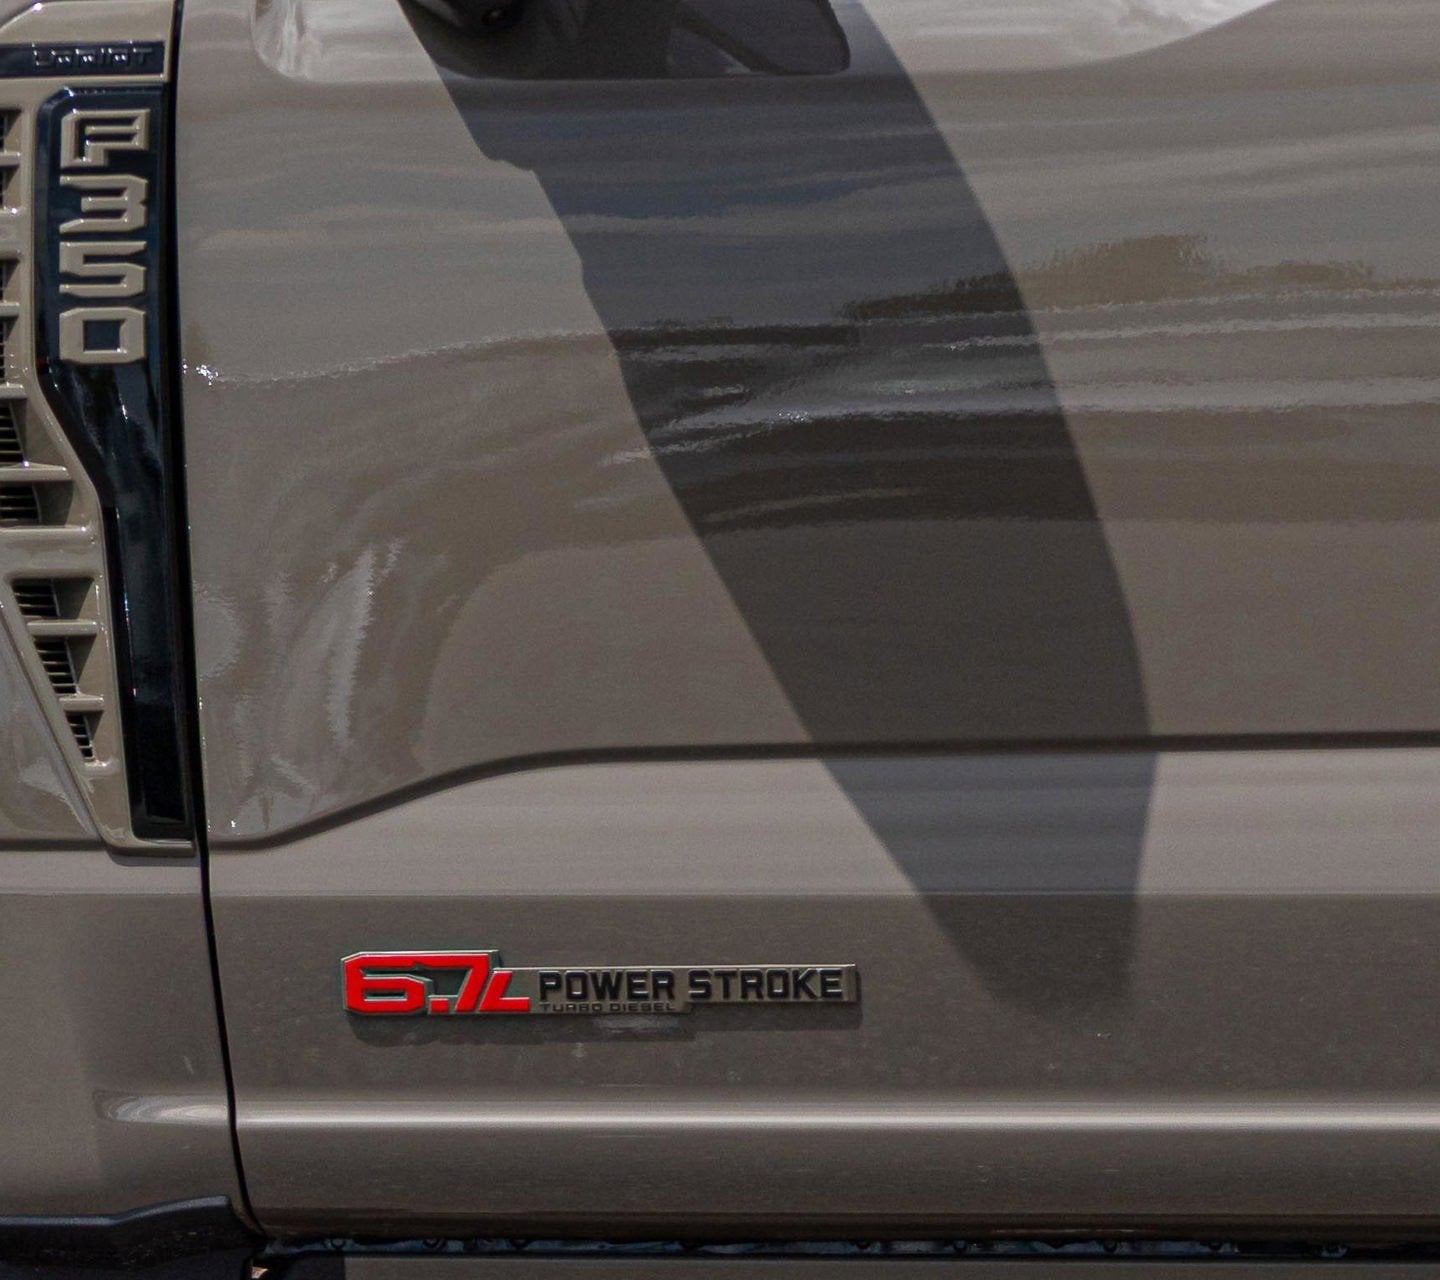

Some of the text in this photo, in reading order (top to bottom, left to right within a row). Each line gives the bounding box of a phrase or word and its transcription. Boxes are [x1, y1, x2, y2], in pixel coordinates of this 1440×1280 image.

[59, 108, 150, 365] F350
[342, 952, 844, 1013] 6.7L POWER STROKE
[539, 1000, 676, 1013] TURBO DIESEL
